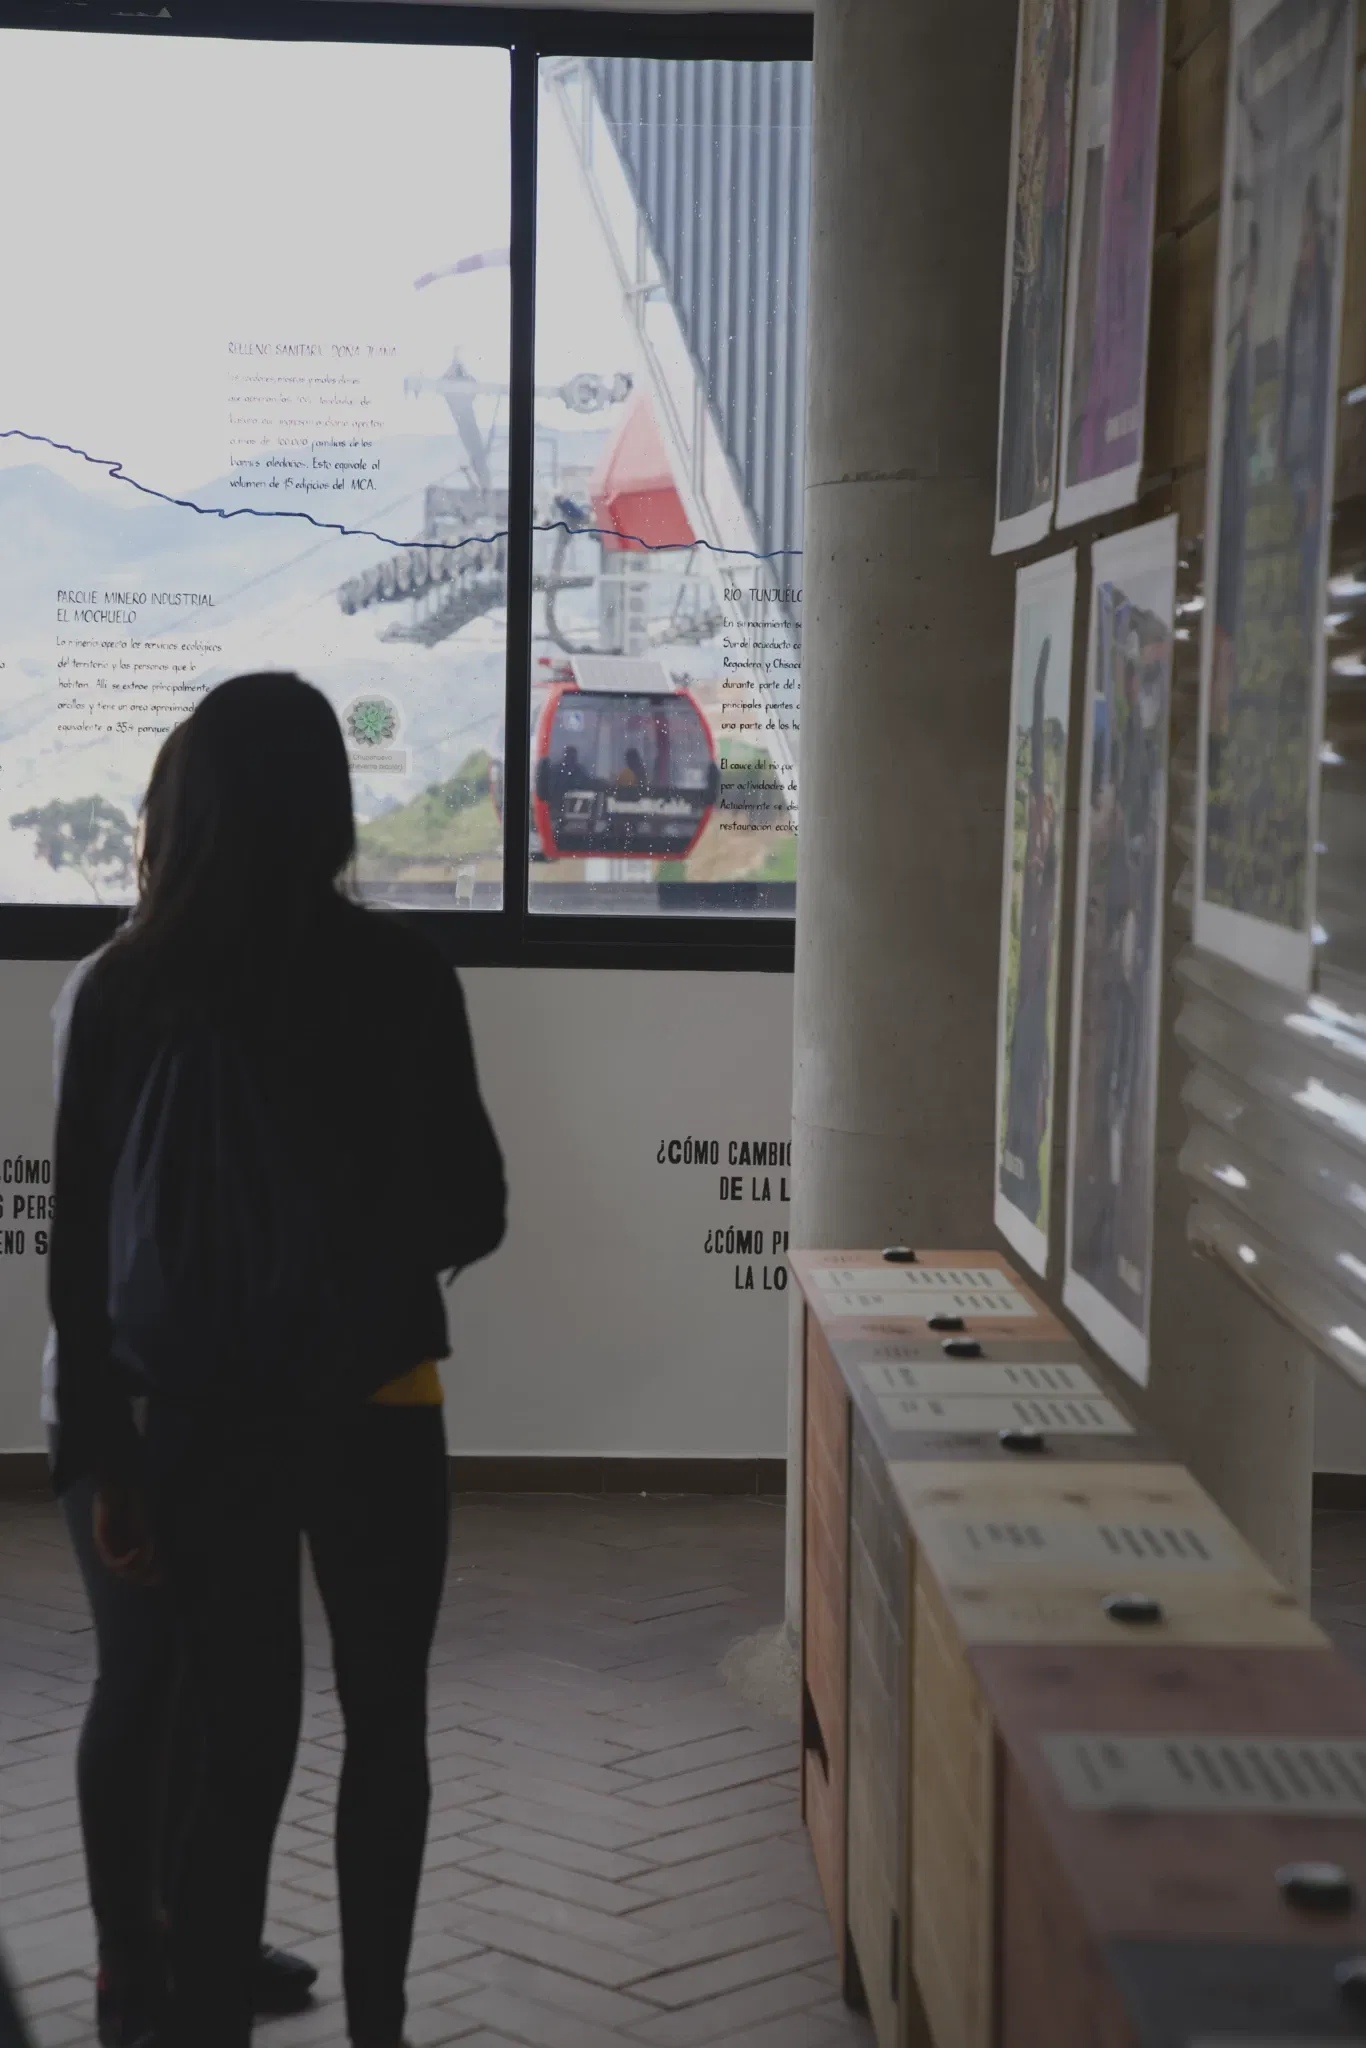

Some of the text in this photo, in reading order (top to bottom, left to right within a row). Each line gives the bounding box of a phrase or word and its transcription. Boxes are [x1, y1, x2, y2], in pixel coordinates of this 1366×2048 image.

[229, 476, 267, 489] volumen
[268, 476, 280, 489] de
[332, 477, 345, 490] del
[104, 591, 147, 605] MINERO
[151, 592, 217, 607] INDUSTRIAL
[57, 608, 137, 624] EL MOCHUELO
[723, 616, 734, 628] En
[172, 663, 187, 674] que
[722, 677, 755, 690] durante
[758, 680, 780, 694] parte
[765, 718, 776, 730] de
[779, 718, 790, 730] los
[720, 758, 728, 770] El
[755, 759, 766, 770] del
[656, 1135, 719, 1165] ¿CÓMO
[0, 1155, 51, 1185] CÓMO
[720, 1176, 743, 1201] DE
[752, 1177, 771, 1201] LA
[704, 1225, 764, 1255] ¿CÓMO
[735, 1265, 754, 1290] LA
